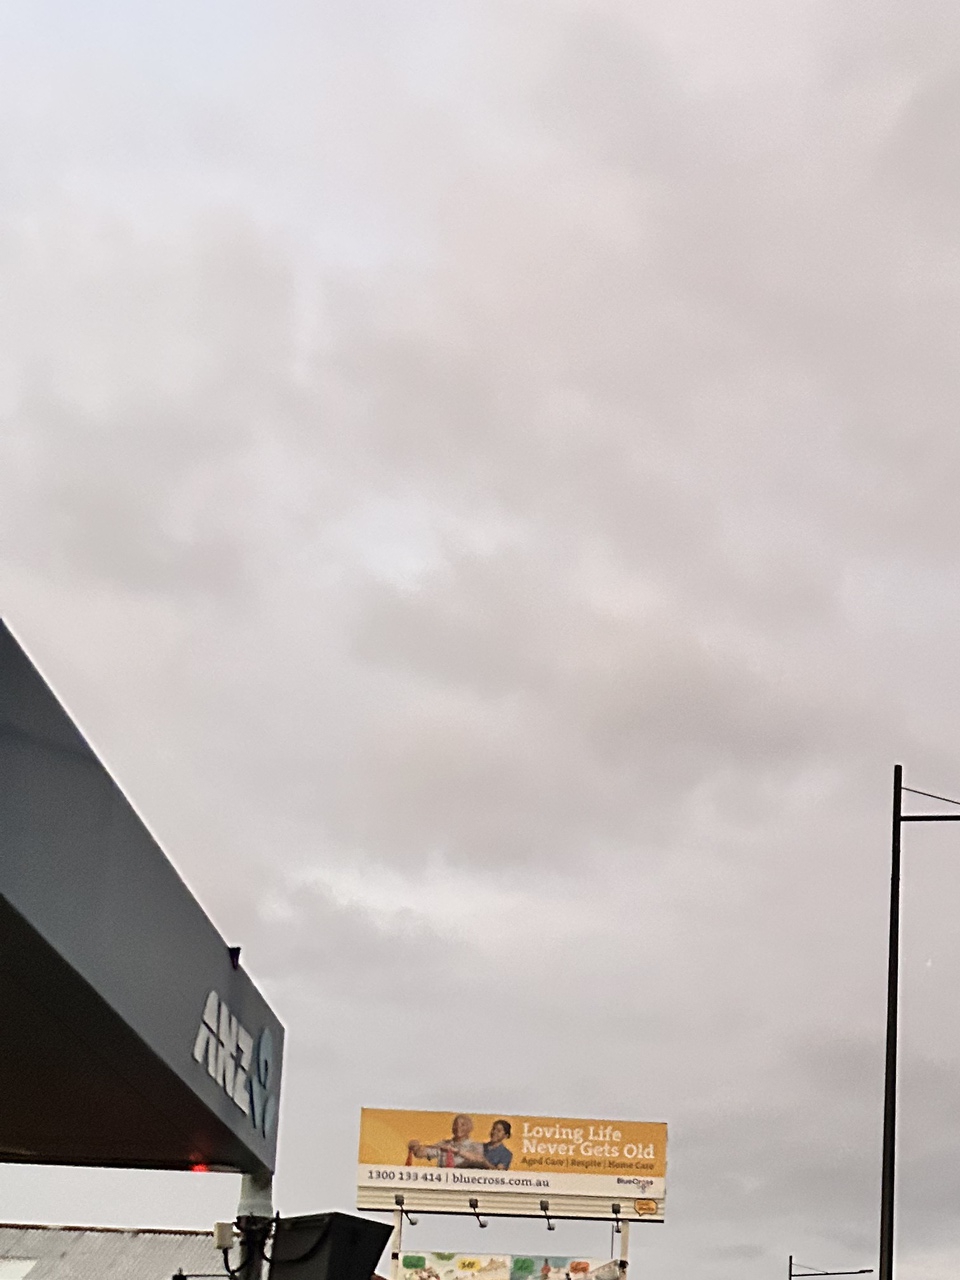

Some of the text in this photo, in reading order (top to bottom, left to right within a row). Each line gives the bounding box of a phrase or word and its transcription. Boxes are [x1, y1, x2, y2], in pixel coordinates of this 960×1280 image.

[522, 1122, 622, 1144] Loving Life
[521, 1139, 655, 1159] Never Gets Old
[521, 1157, 655, 1170] Aged Care Respite Home Care
[367, 1170, 550, 1188] 1300 133 414 bluecross.com.au
[616, 1177, 654, 1186] BlueCross
